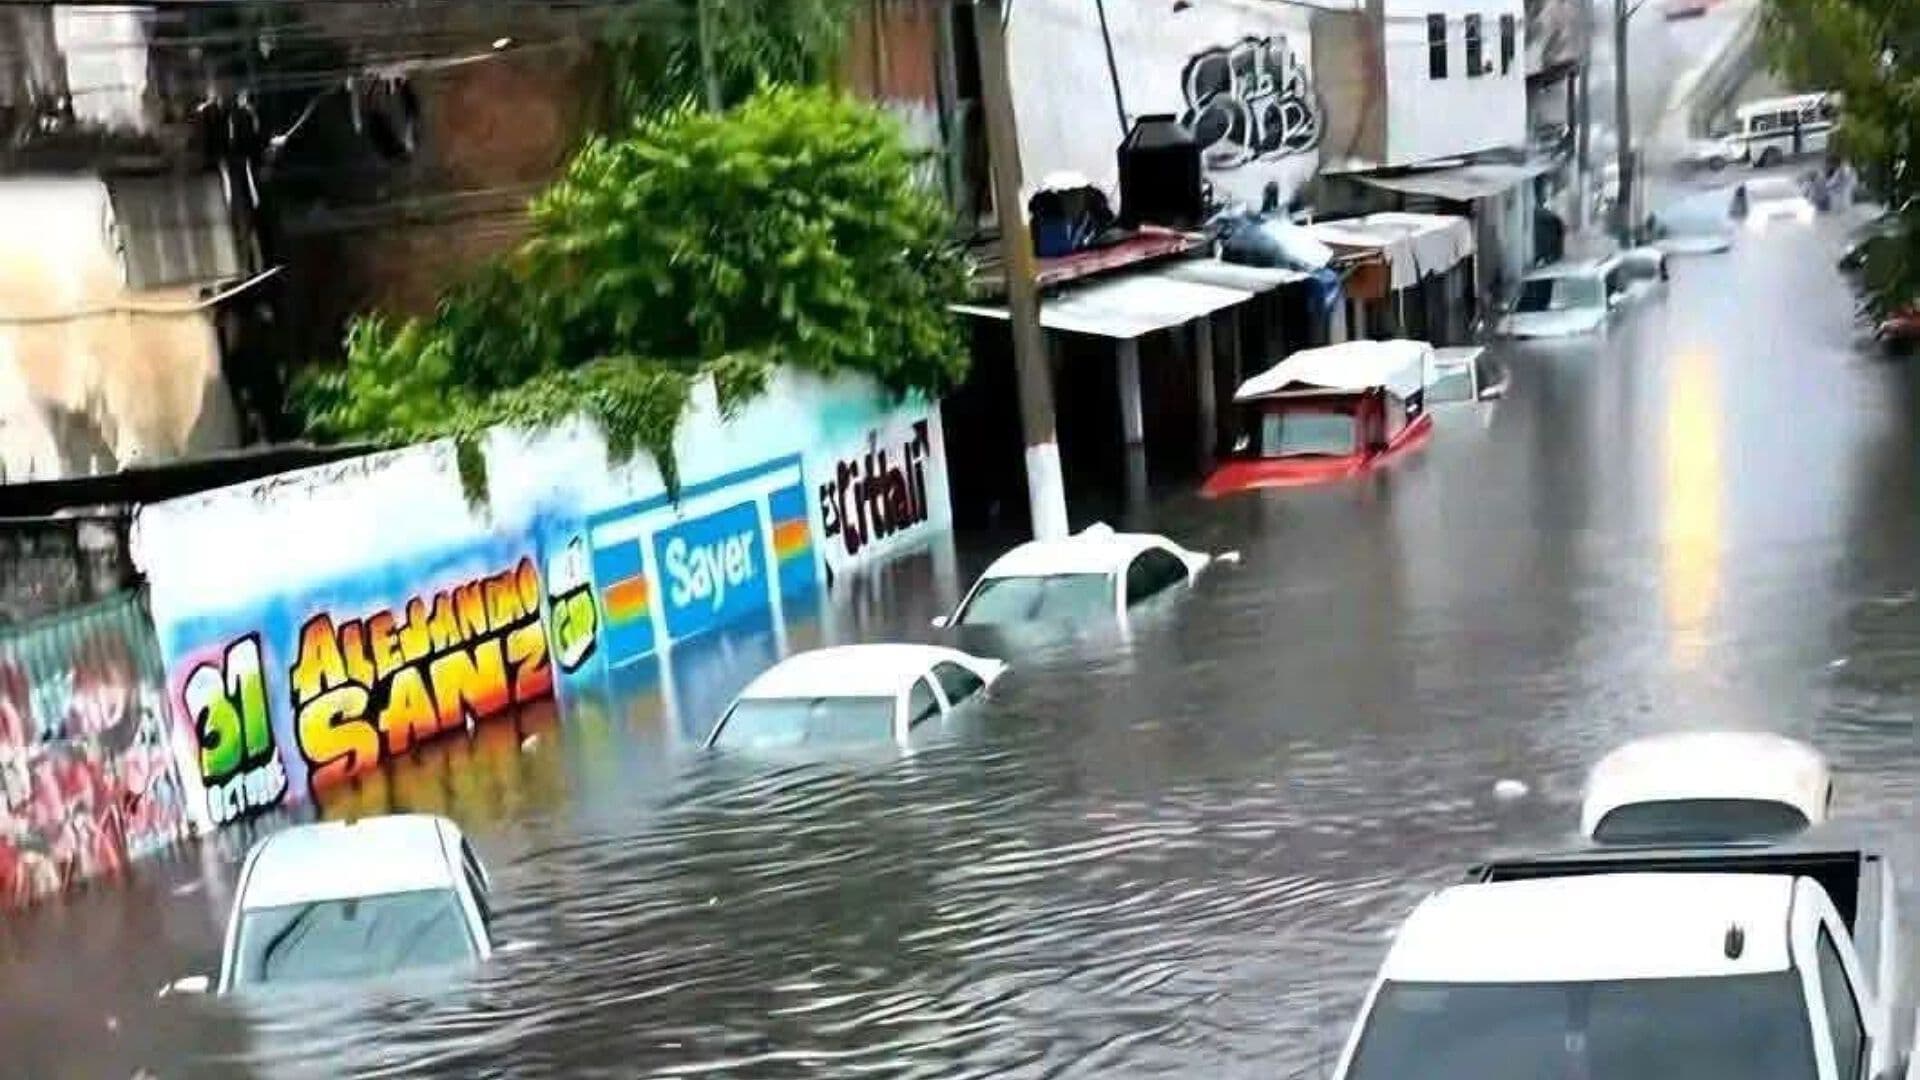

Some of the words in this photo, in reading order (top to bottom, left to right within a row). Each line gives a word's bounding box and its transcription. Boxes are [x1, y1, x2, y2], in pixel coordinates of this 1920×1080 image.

[290, 556, 541, 704] ALEJANDRO
[665, 529, 753, 614] Sayer
[183, 632, 274, 787] 31
[298, 622, 553, 794] SANZ
[206, 746, 288, 825] OCTU
